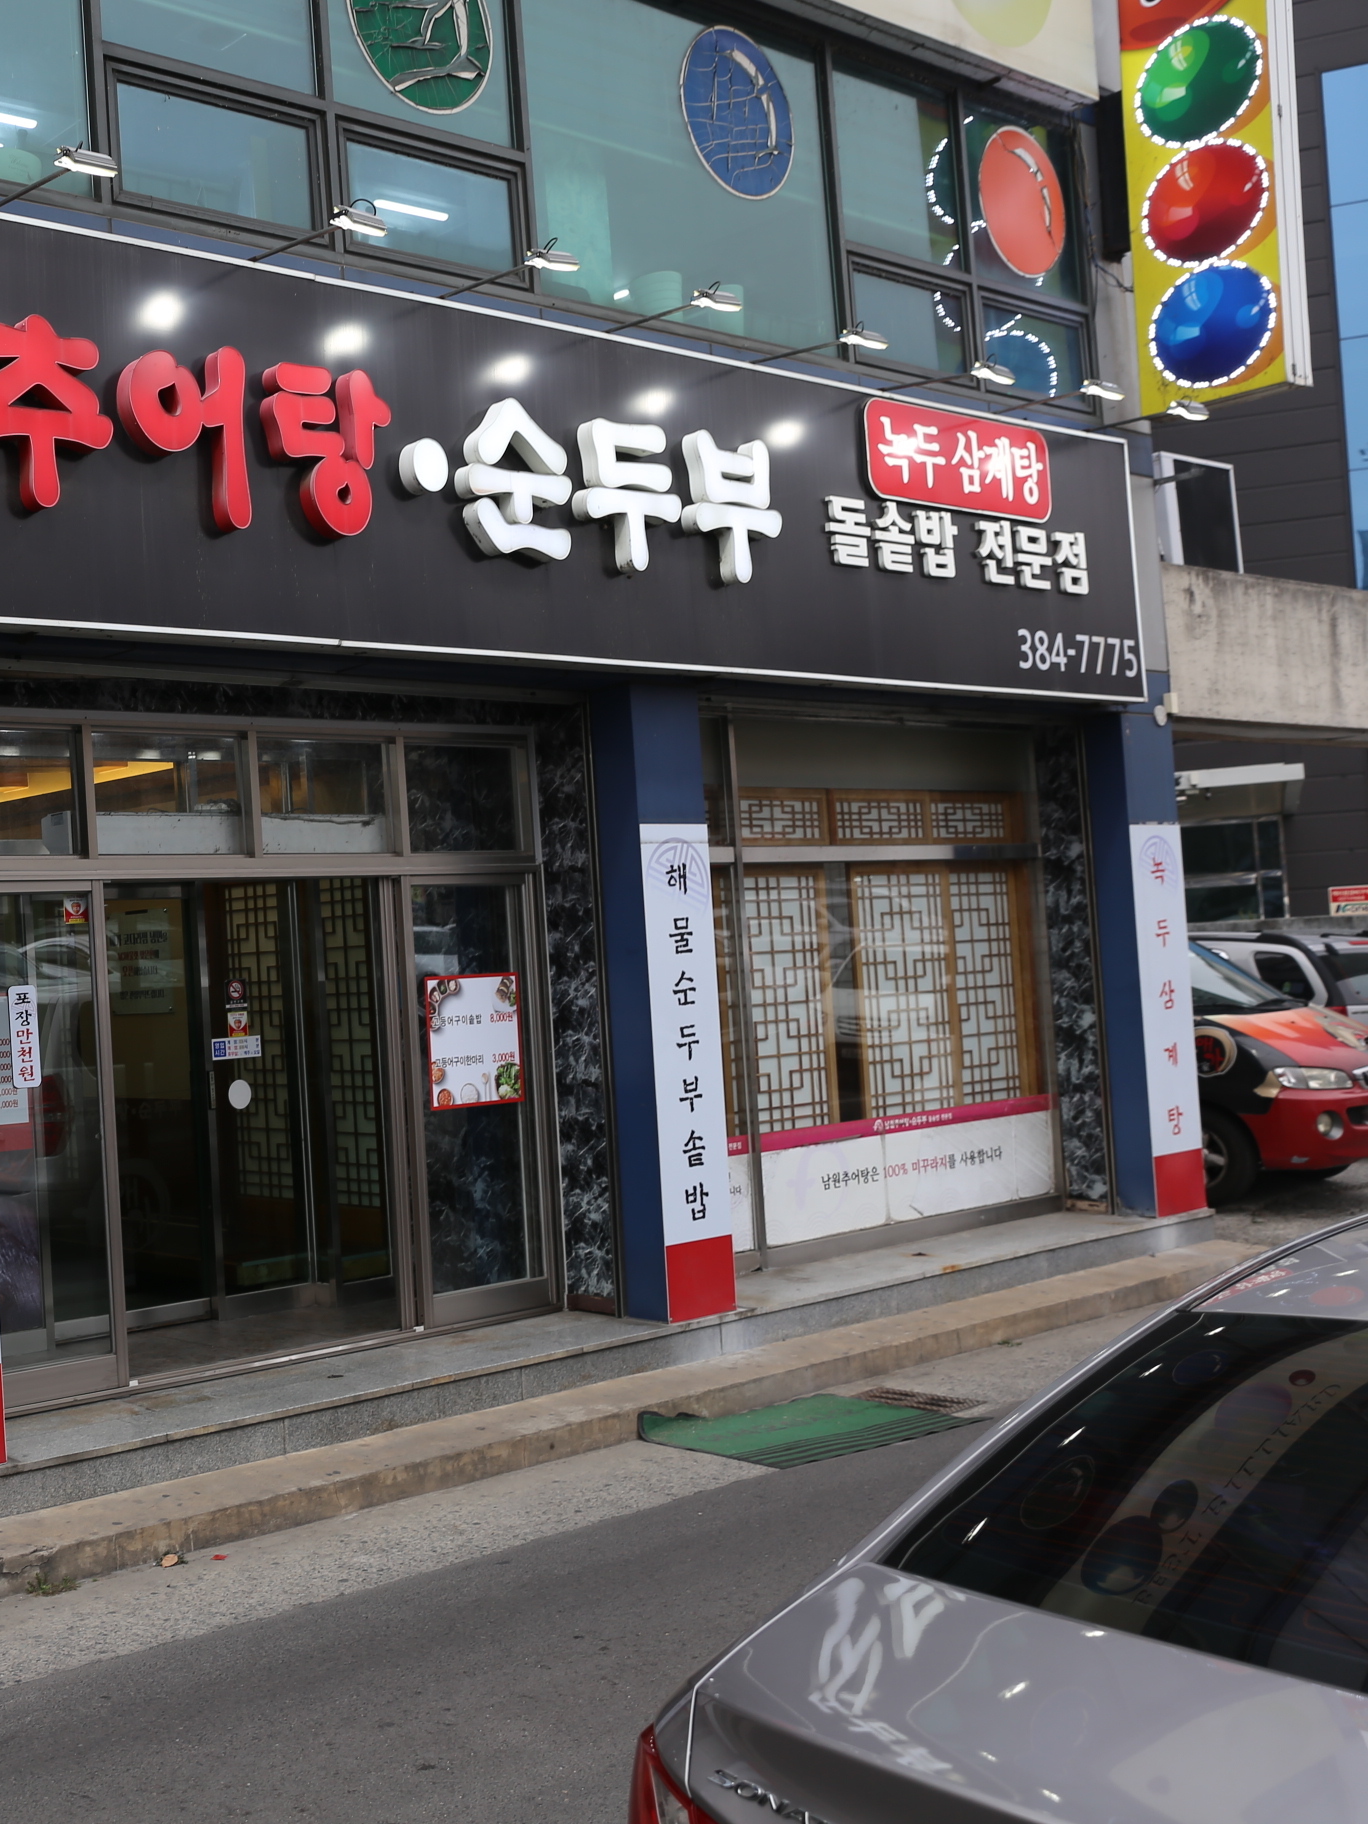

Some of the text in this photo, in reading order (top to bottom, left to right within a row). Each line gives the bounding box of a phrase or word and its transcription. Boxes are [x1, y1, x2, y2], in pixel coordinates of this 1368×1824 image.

[877, 416, 1044, 505] 녹두 삼계탕
[824, 495, 1090, 595] 돌솥밥 전문점
[1017, 628, 1139, 678] 384-7775
[490, 1012, 513, 1023] 8,000원
[435, 1052, 515, 1068] 고등어구이한마리 3,000원
[821, 1146, 1002, 1190] 남원추어탕은 100% 미꾸라지를 사용합니다
